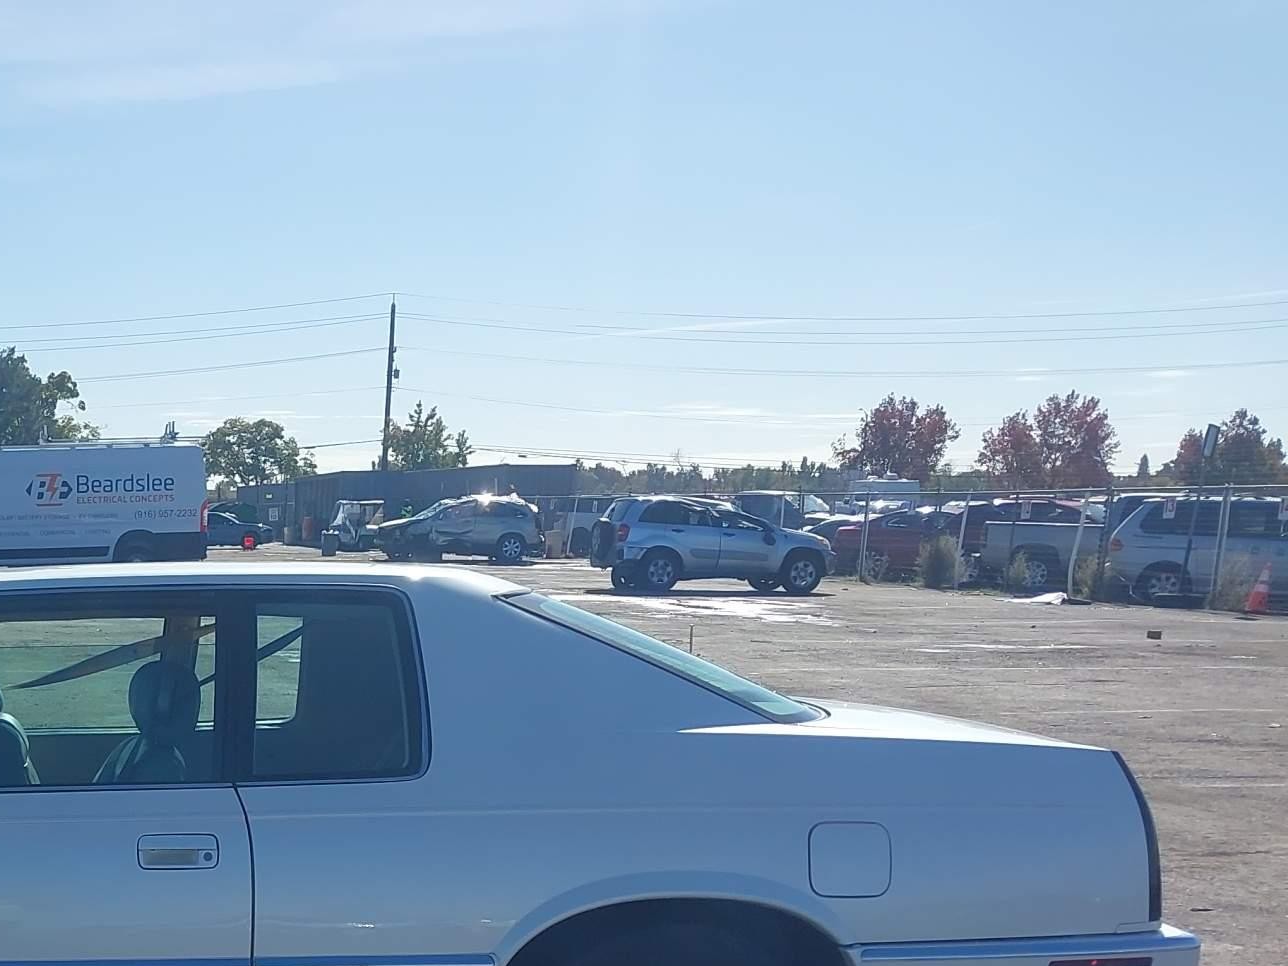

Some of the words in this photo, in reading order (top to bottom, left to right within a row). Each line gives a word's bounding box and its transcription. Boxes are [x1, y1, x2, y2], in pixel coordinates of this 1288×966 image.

[76, 473, 175, 494] Beardslee
[76, 495, 128, 505] ELECTRICAL
[130, 494, 175, 504] CONCEPTS
